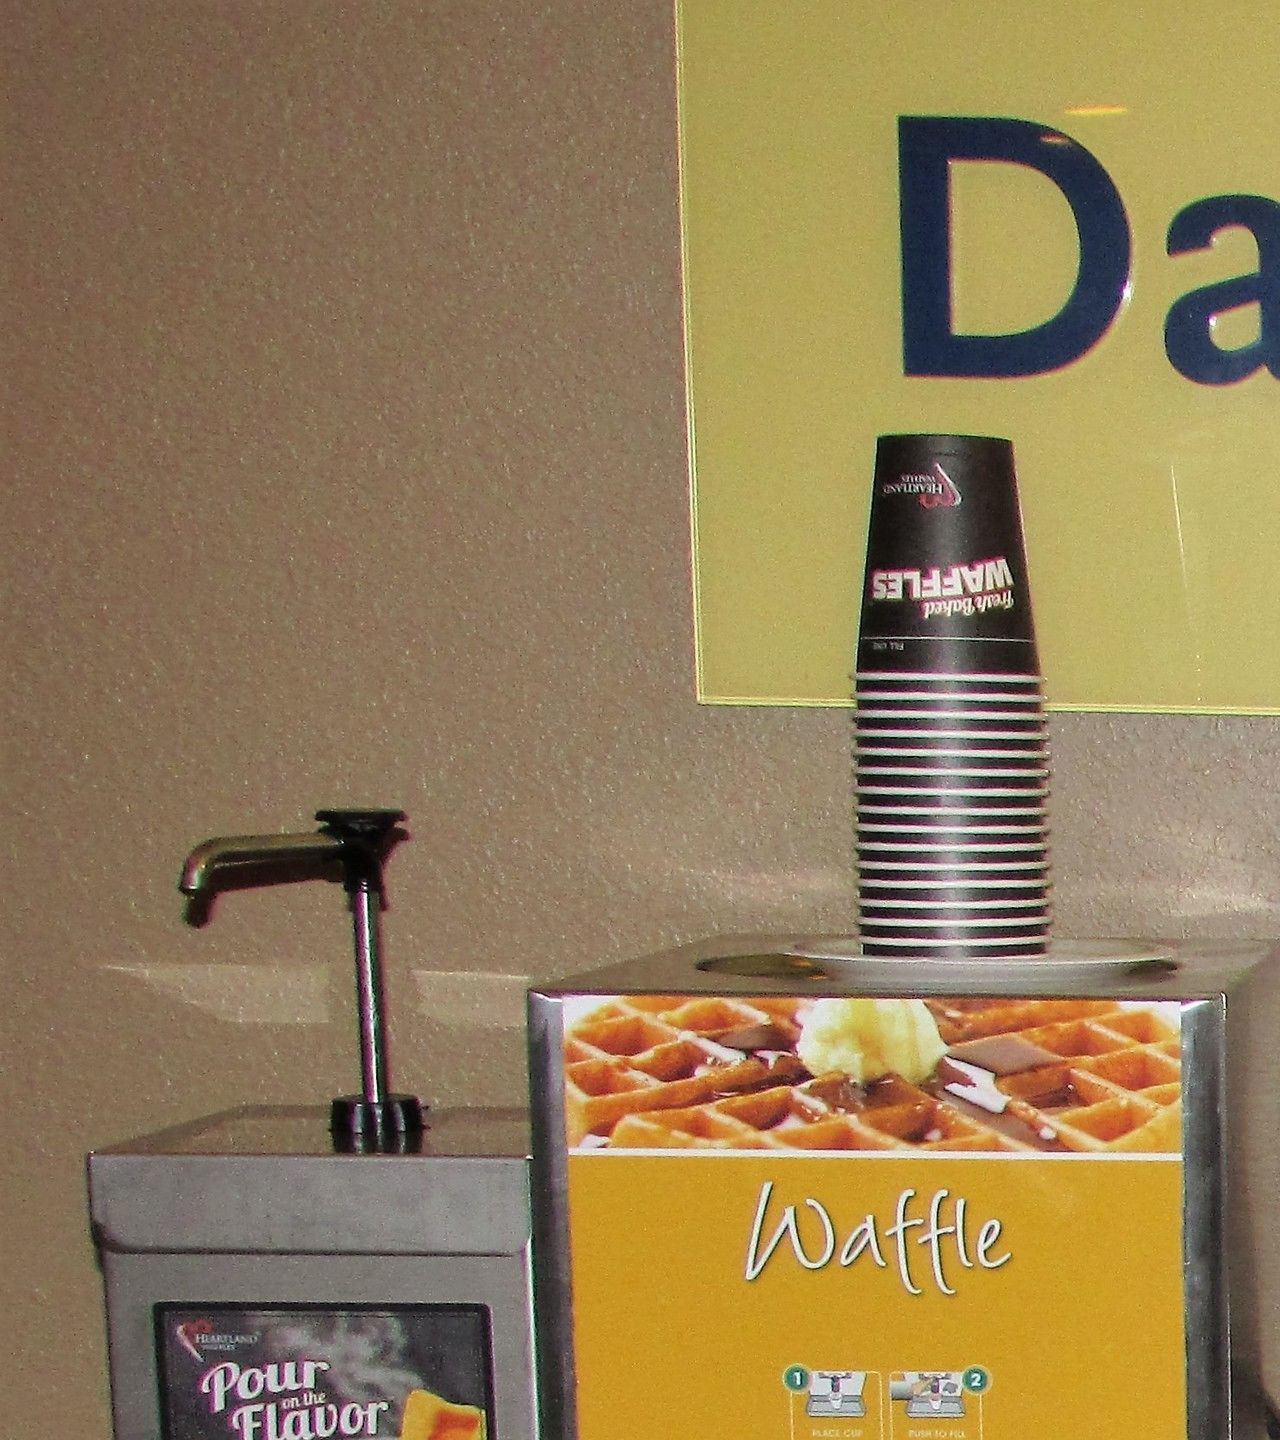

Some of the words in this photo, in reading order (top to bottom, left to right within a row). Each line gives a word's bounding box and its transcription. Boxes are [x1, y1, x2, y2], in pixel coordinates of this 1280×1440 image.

[872, 558, 1015, 600] WAFFLES
[924, 597, 974, 619] Baked
[974, 589, 1014, 610] Fresh
[744, 1181, 1012, 1295] Waffle
[201, 1360, 332, 1414] Pour
[794, 1372, 802, 1386] 1
[970, 1372, 982, 1387] 2
[282, 1396, 300, 1410] on
[302, 1390, 328, 1406] the
